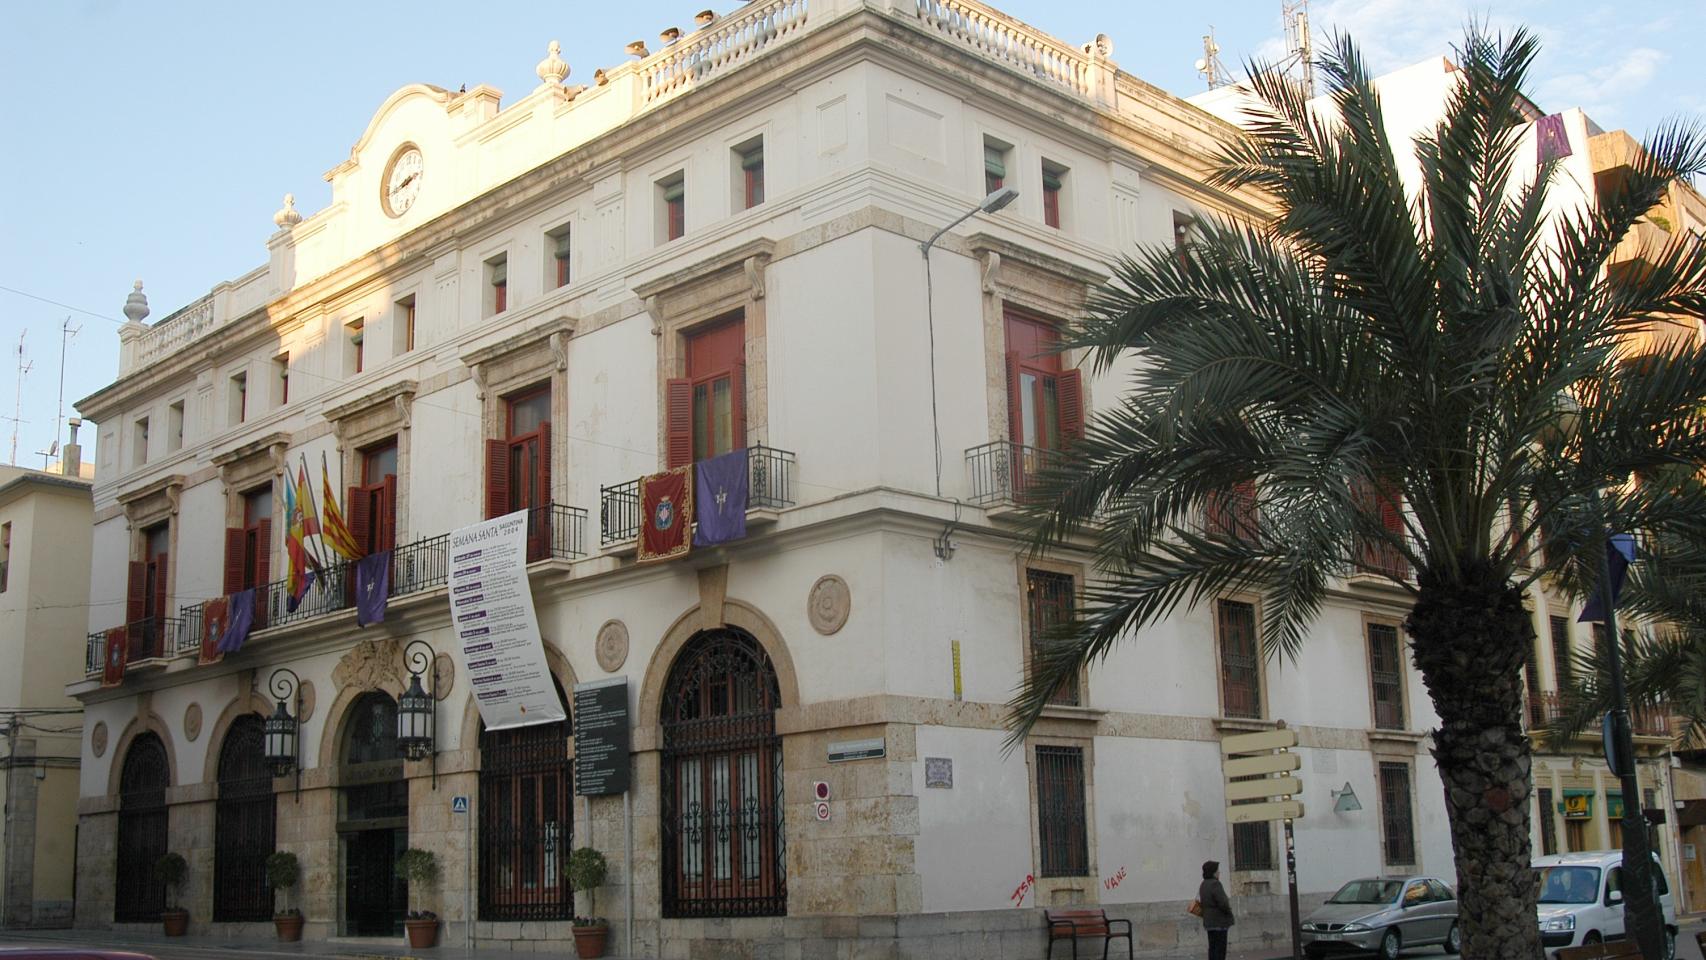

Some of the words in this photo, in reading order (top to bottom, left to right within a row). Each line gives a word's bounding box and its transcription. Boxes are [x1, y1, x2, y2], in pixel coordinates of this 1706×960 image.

[452, 532, 478, 548] SEMANA
[478, 526, 498, 541] SANTA
[1011, 874, 1035, 907] ISA
